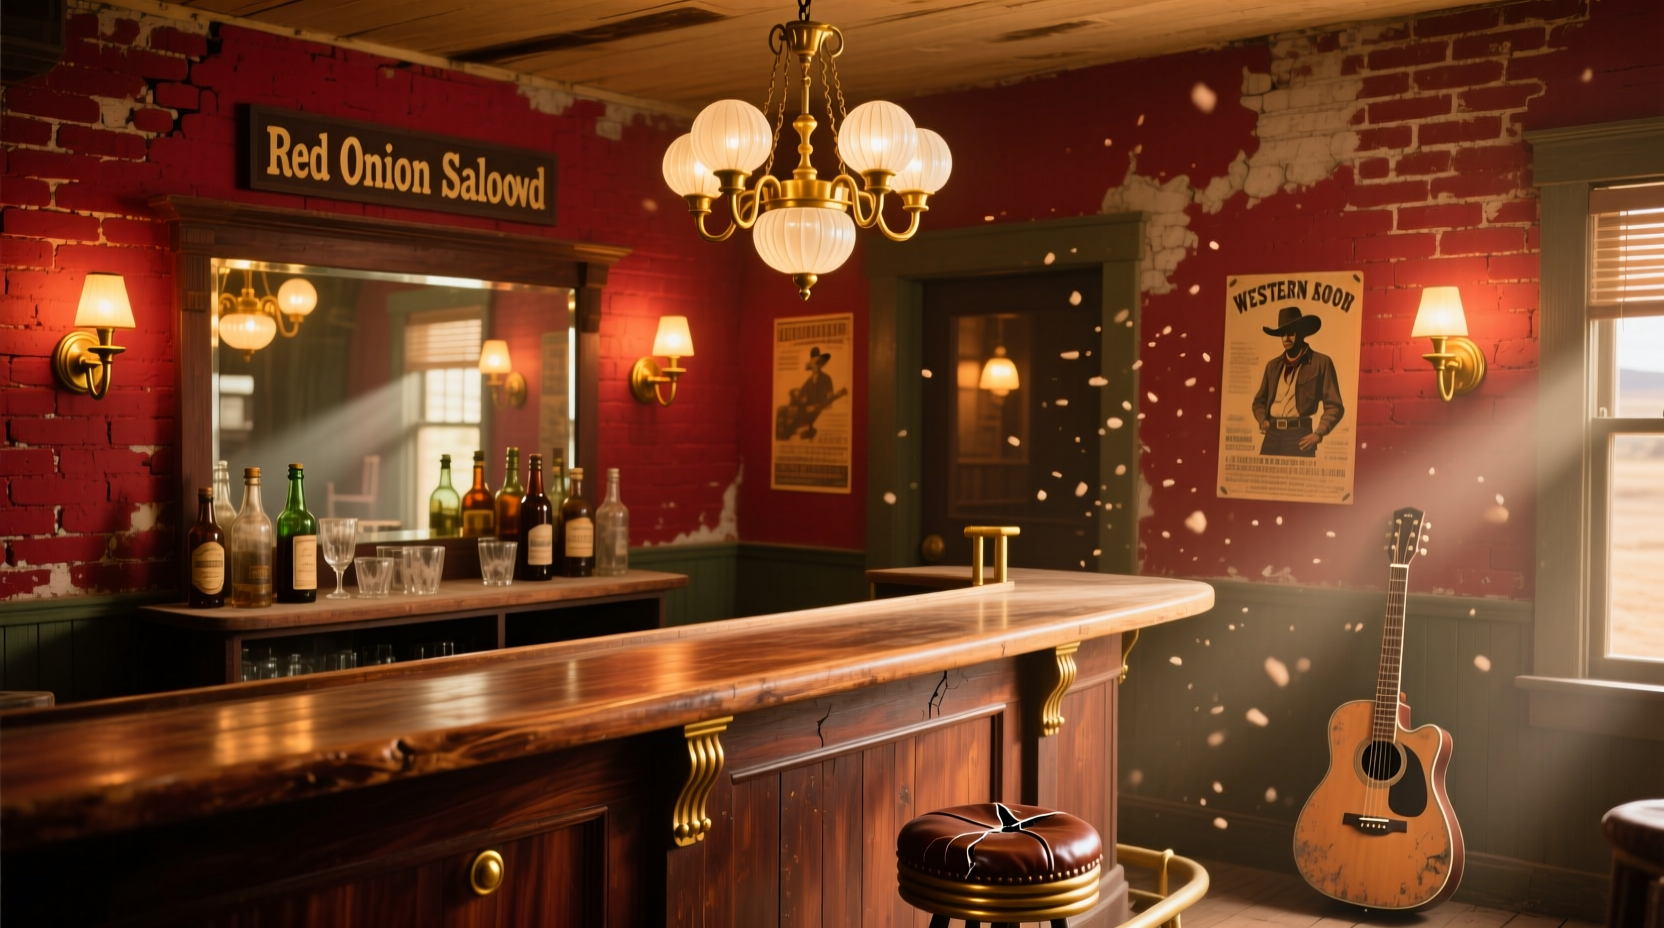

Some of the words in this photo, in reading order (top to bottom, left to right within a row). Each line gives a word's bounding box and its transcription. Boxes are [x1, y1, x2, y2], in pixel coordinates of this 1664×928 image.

[266, 125, 330, 181] Red
[340, 136, 431, 194] Onion
[1233, 280, 1308, 314] WESTERN
